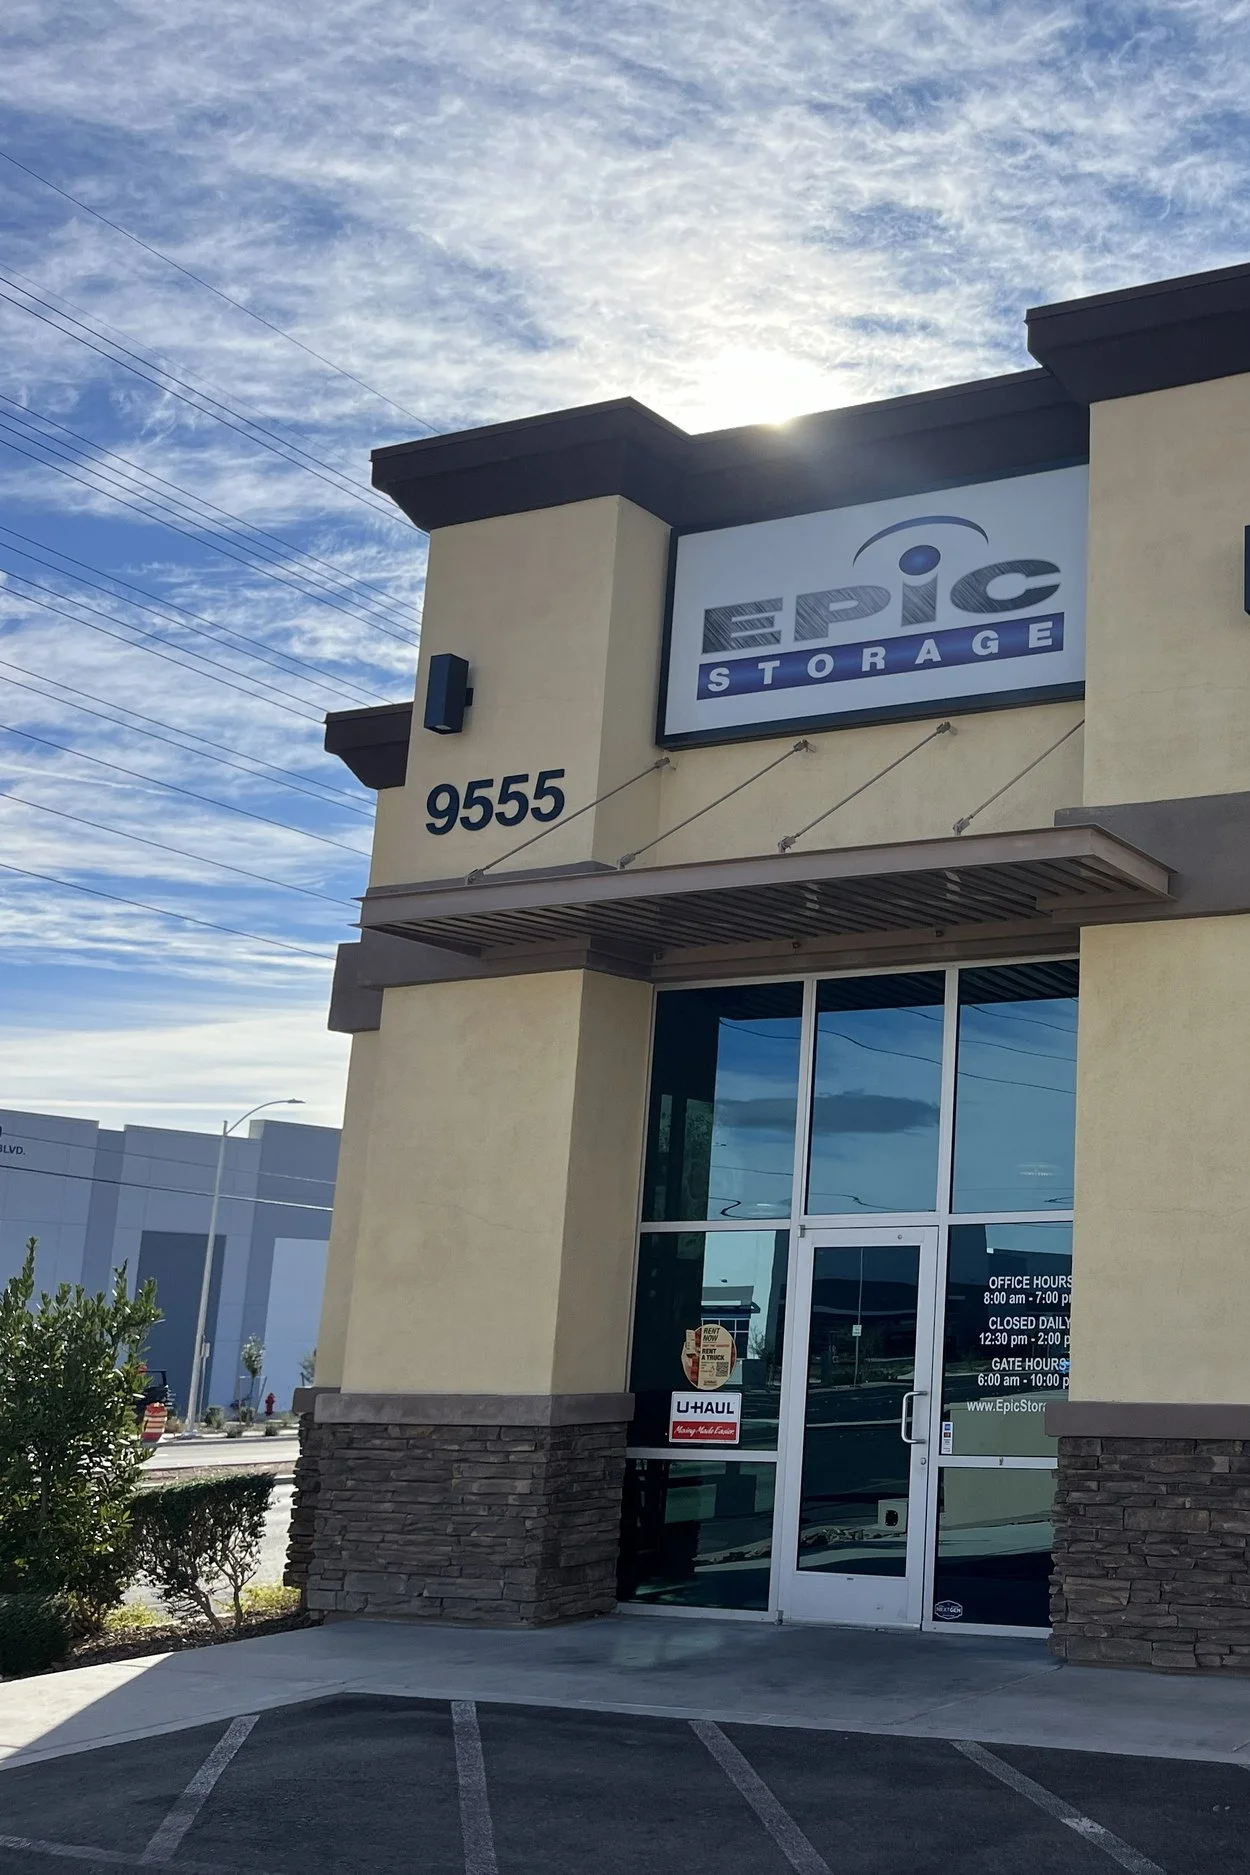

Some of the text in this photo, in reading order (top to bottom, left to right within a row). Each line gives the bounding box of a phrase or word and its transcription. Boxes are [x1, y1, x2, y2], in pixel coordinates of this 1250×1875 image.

[707, 621, 1054, 692] STORAGE
[426, 769, 565, 835] 9555
[989, 1275, 1073, 1289] OFFICE HOURS
[984, 1292, 1006, 1304] 8:00
[1009, 1294, 1025, 1304] am
[1035, 1291, 1058, 1304] 7:00
[989, 1316, 1071, 1330] CLOSED DAILY
[979, 1332, 1008, 1345] 12:30
[1010, 1335, 1028, 1348] pm
[1037, 1332, 1061, 1345] 2:00
[992, 1358, 1066, 1370] GATE HOURS
[977, 1374, 1000, 1386] 6:00
[1003, 1376, 1020, 1386] am
[1030, 1374, 1060, 1386] 10:00
[677, 1401, 734, 1414] U-HAUL
[697, 1425, 714, 1434] Made
